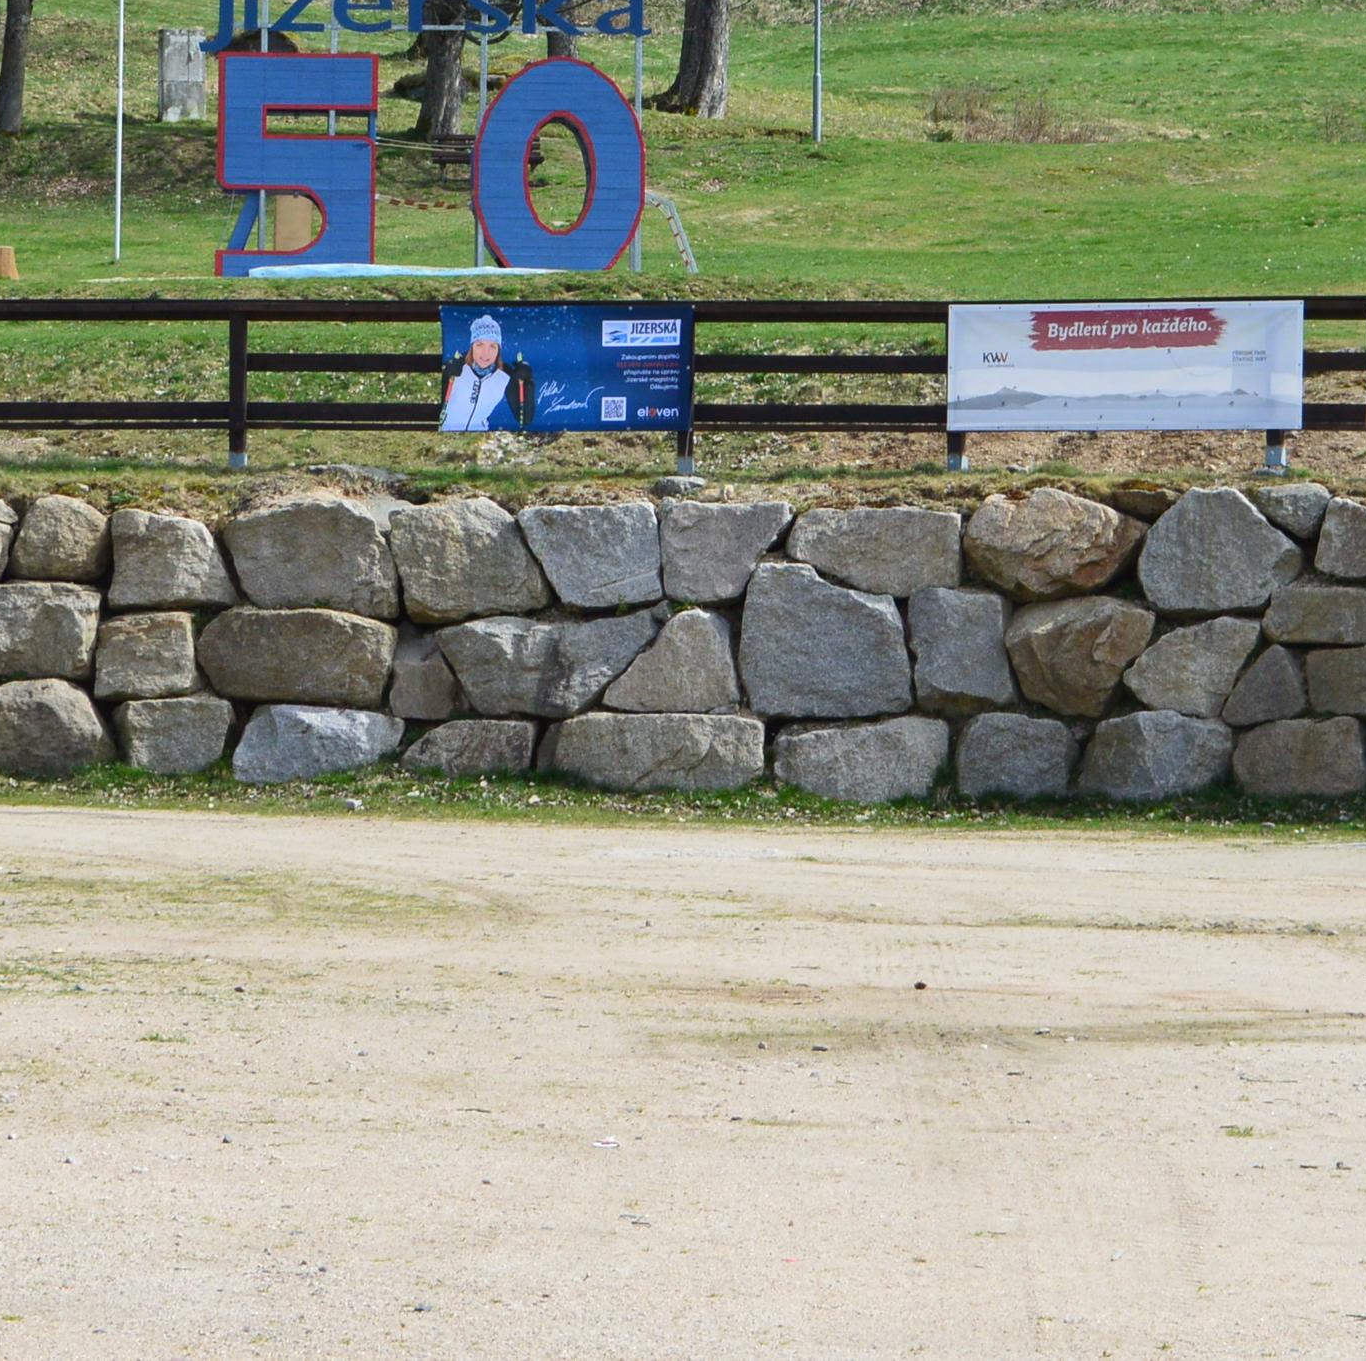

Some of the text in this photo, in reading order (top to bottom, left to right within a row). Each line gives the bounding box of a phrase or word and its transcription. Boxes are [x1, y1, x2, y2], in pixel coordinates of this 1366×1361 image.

[214, 51, 646, 278] 50
[1047, 315, 1212, 341] Bydlení pro každého.
[637, 406, 679, 417] eleven
